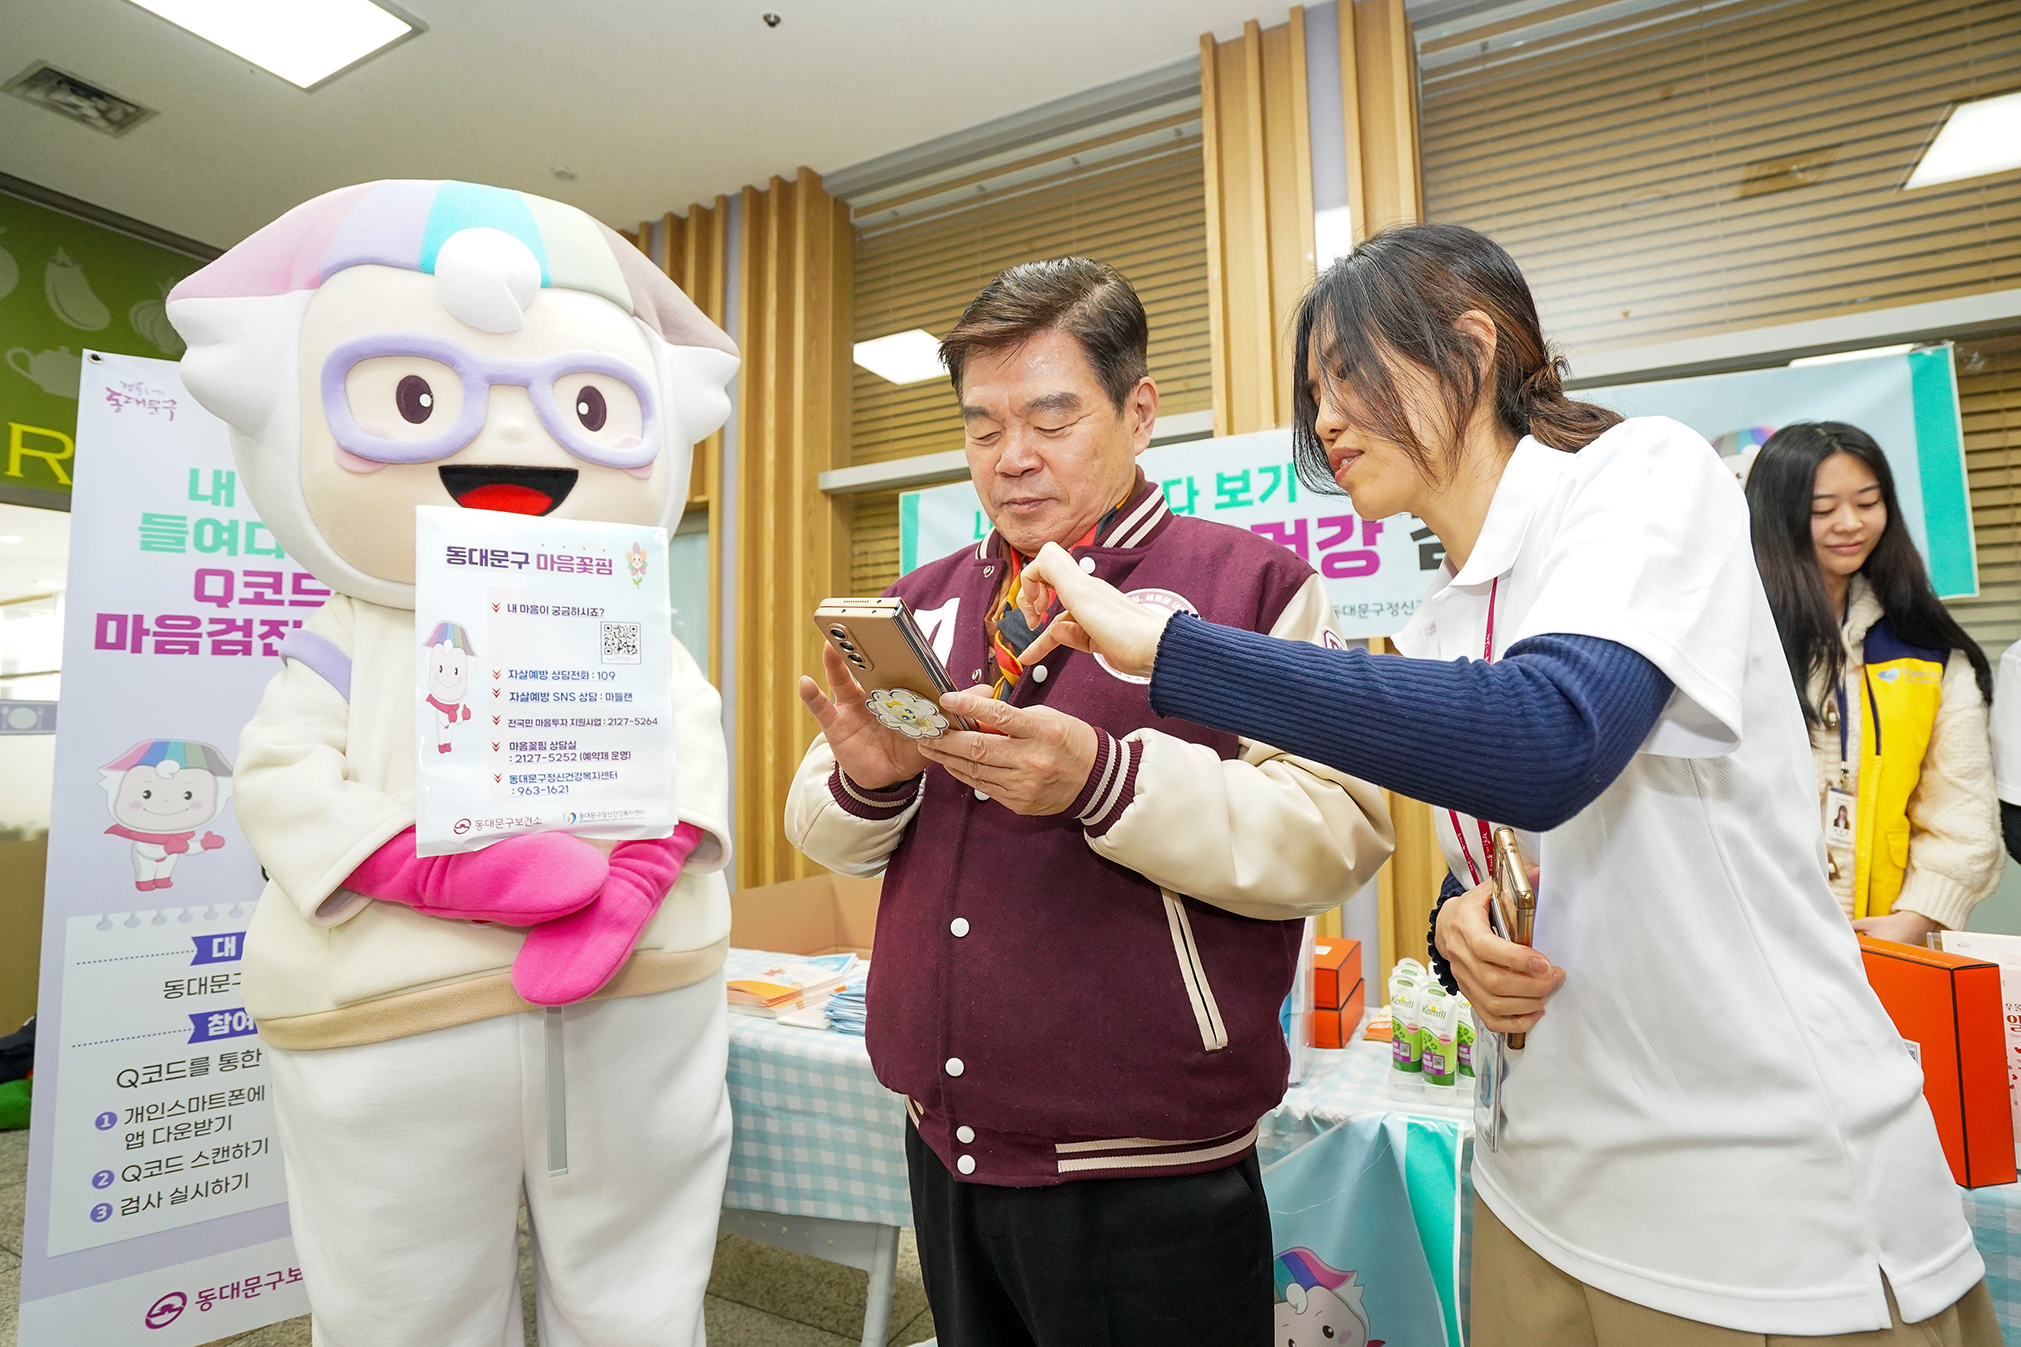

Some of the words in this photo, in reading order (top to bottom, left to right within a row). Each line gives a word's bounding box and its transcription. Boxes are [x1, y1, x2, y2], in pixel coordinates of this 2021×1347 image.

[4, 421, 74, 486] R
[188, 468, 236, 507] 내
[1214, 462, 1298, 511] 보기
[446, 545, 530, 569] 동대문구
[536, 553, 613, 576] 마음꽃핌
[194, 568, 331, 608] Q코드
[507, 604, 517, 613] 내
[520, 604, 549, 615] 마음이
[551, 606, 605, 617] 궁금하시죠?
[508, 669, 548, 680] 자살예방
[551, 670, 589, 680] 상담전화
[597, 671, 616, 680] 109
[509, 692, 550, 702] 자살예방
[553, 692, 576, 702] SNS
[579, 692, 598, 702] 상담
[508, 718, 533, 728] 전국민
[535, 718, 568, 728] 마음투자
[570, 717, 602, 727] 지원사업
[607, 717, 658, 726] 2127-5264
[509, 741, 547, 751] 마음꽃핌
[549, 740, 577, 750] 상담실
[515, 753, 577, 763] 2127-5252
[579, 751, 609, 761] (예약제
[611, 750, 632, 761] 운영)
[509, 771, 618, 784] 동대문구정신건강복지센터
[517, 784, 569, 795] 963-1621
[475, 816, 543, 831] 동대문구보건소
[212, 935, 237, 958] 대
[208, 1011, 255, 1036] 참여
[1421, 1005, 1447, 1020] Kamill
[117, 1056, 210, 1088] Q코드를
[218, 1049, 262, 1072] 통한
[124, 1085, 265, 1125] 개인스마트폰에
[125, 1131, 145, 1150] 앱
[152, 1115, 232, 1144] 다운받기
[121, 1155, 184, 1183] Q코드
[190, 1138, 269, 1168] 스캔하기
[120, 1191, 163, 1217] 검사
[169, 1172, 249, 1205] 실시하기
